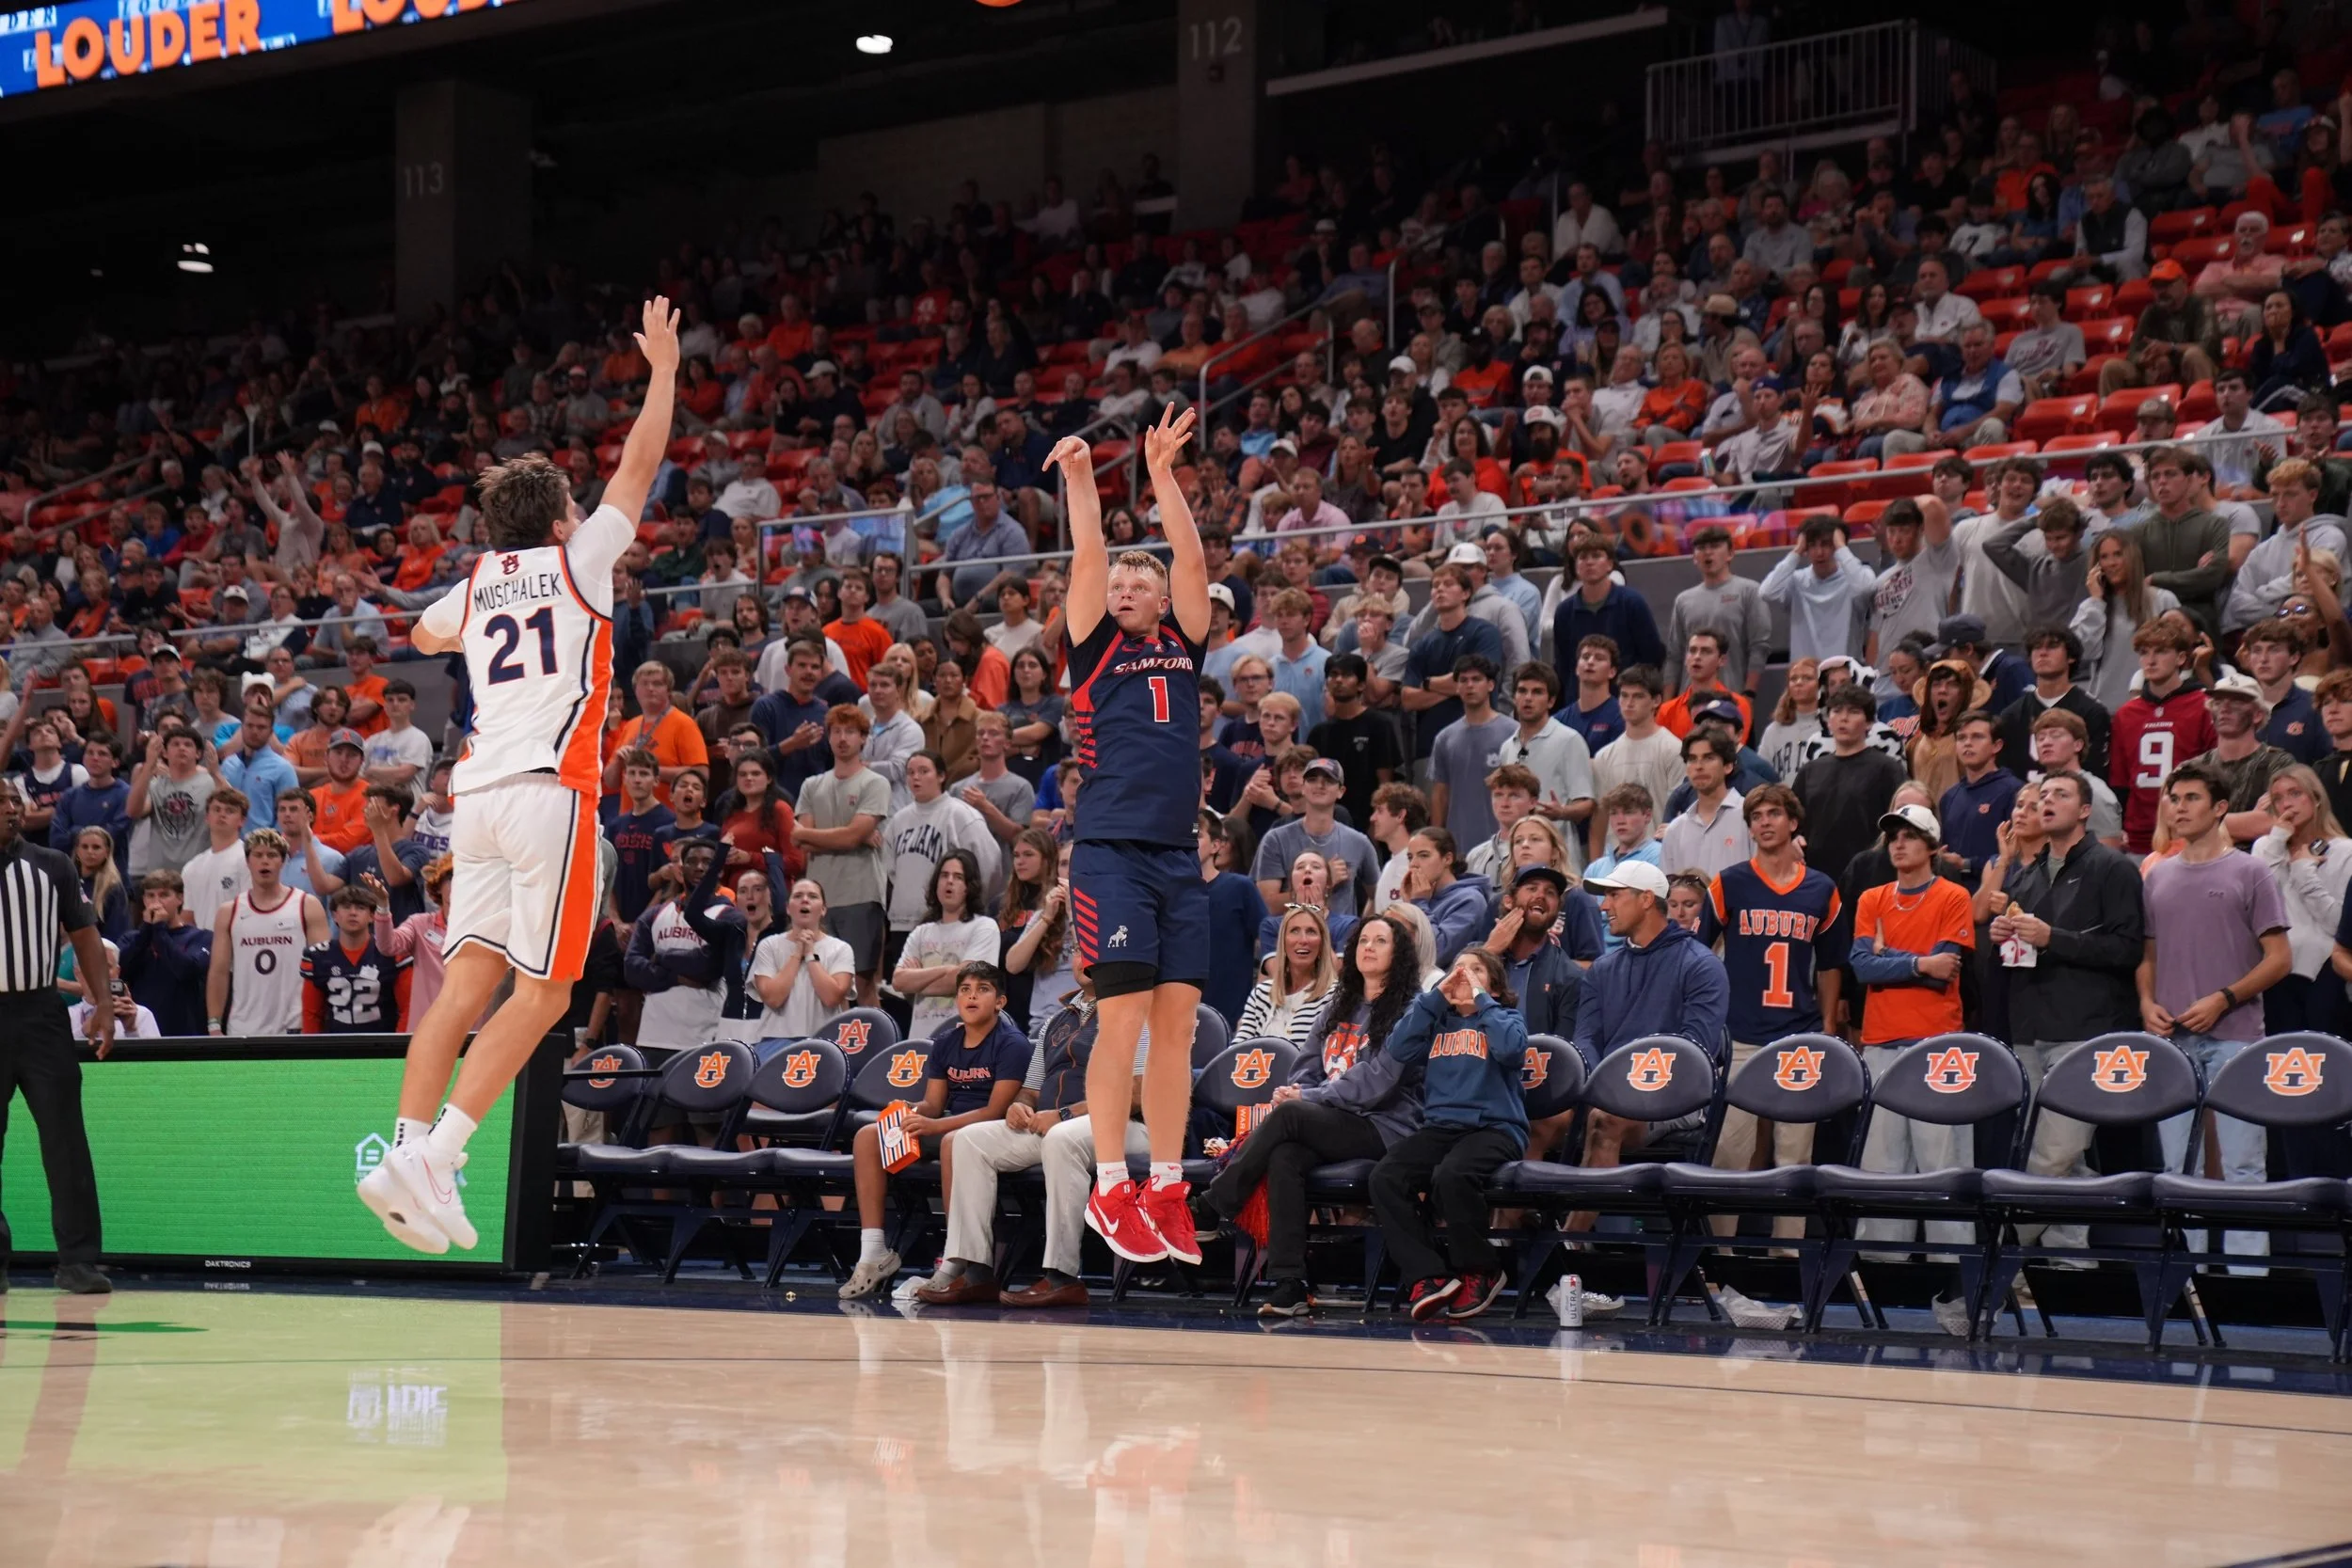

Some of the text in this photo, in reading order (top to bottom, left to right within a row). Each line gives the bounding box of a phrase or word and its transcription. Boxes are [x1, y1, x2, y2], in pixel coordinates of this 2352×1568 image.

[35, 0, 261, 87] LOUDER
[1189, 15, 1243, 61] 112
[404, 161, 444, 199] 113
[474, 573, 563, 612] MUSCHALEK
[484, 606, 559, 687] 21
[1114, 657, 1193, 674] SAMFORD
[1148, 675, 1170, 723] 1
[2137, 730, 2175, 788] 9
[240, 935, 294, 948] AUBURN
[1739, 909, 1820, 942] AUBURN
[254, 949, 277, 975] 0
[1762, 942, 1794, 1008] 1
[328, 976, 382, 1025] 22
[1428, 1028, 1489, 1060] AUBURN
[204, 1259, 252, 1269] DAKTRONICS
[1569, 1289, 1578, 1320] ULTRA
